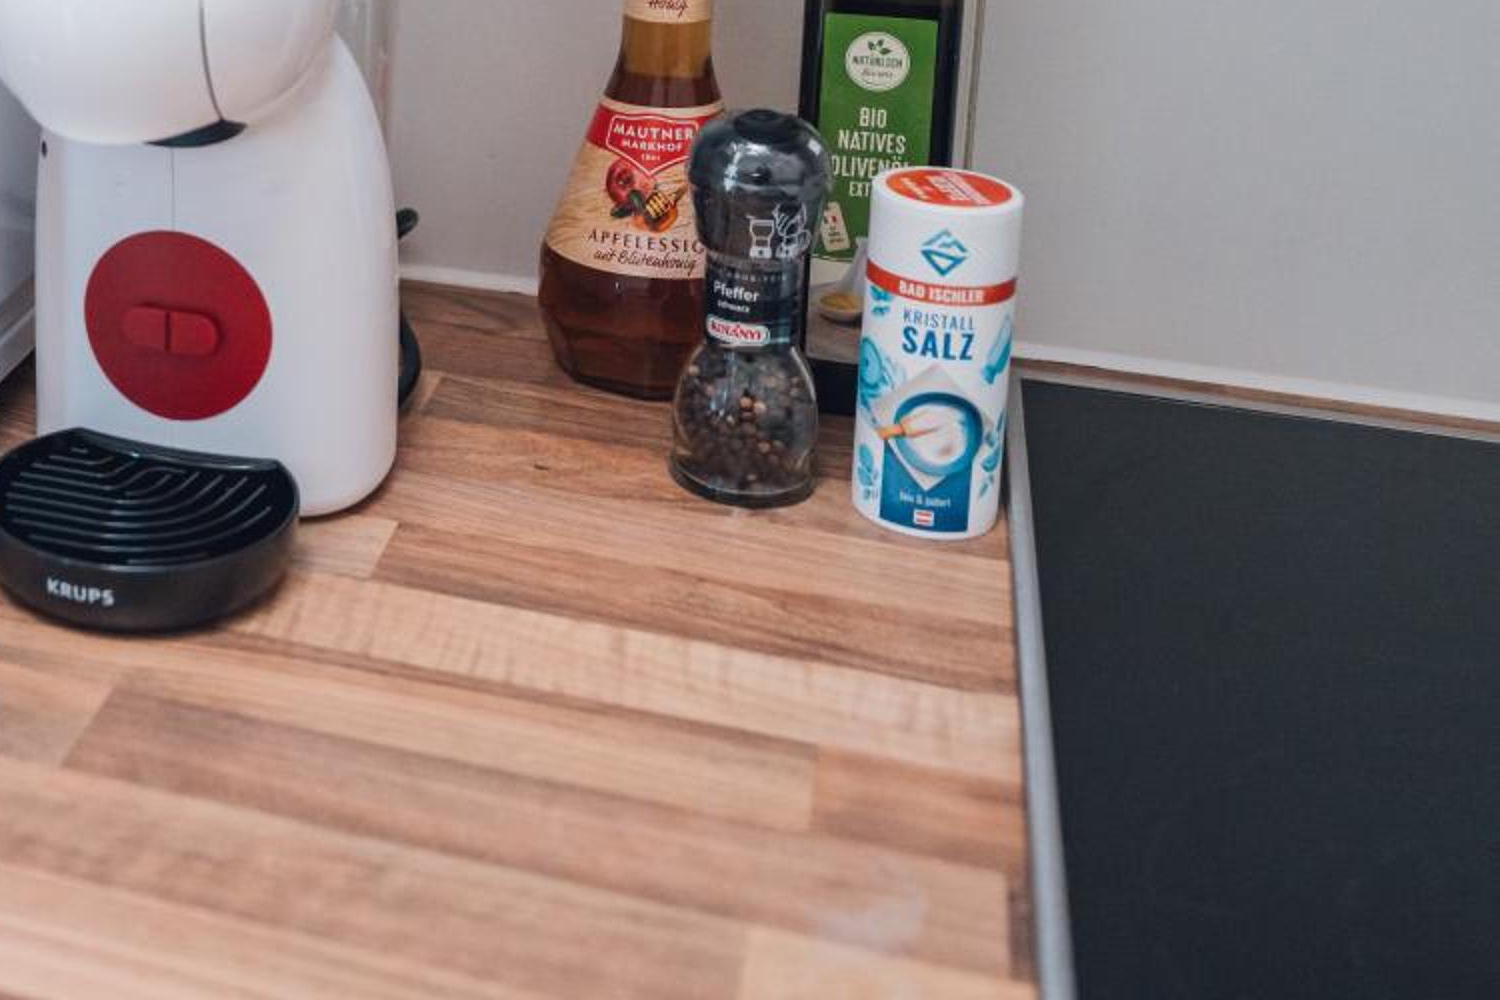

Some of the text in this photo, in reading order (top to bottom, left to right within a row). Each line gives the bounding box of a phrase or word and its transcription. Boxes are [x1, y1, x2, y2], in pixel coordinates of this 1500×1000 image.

[859, 106, 887, 129] BIO
[613, 123, 694, 141] MAUTNER
[837, 129, 907, 154] NATIVES
[622, 138, 682, 152] MARKHOF
[831, 154, 909, 179] OLIVENÖ
[587, 228, 705, 255] APFELESSIG
[713, 280, 760, 302] Pfeffer
[899, 279, 985, 303] BAD ISCHLER
[902, 307, 977, 331] KRISTALL
[902, 325, 975, 361] SALZ
[46, 577, 115, 607] KRUPS
